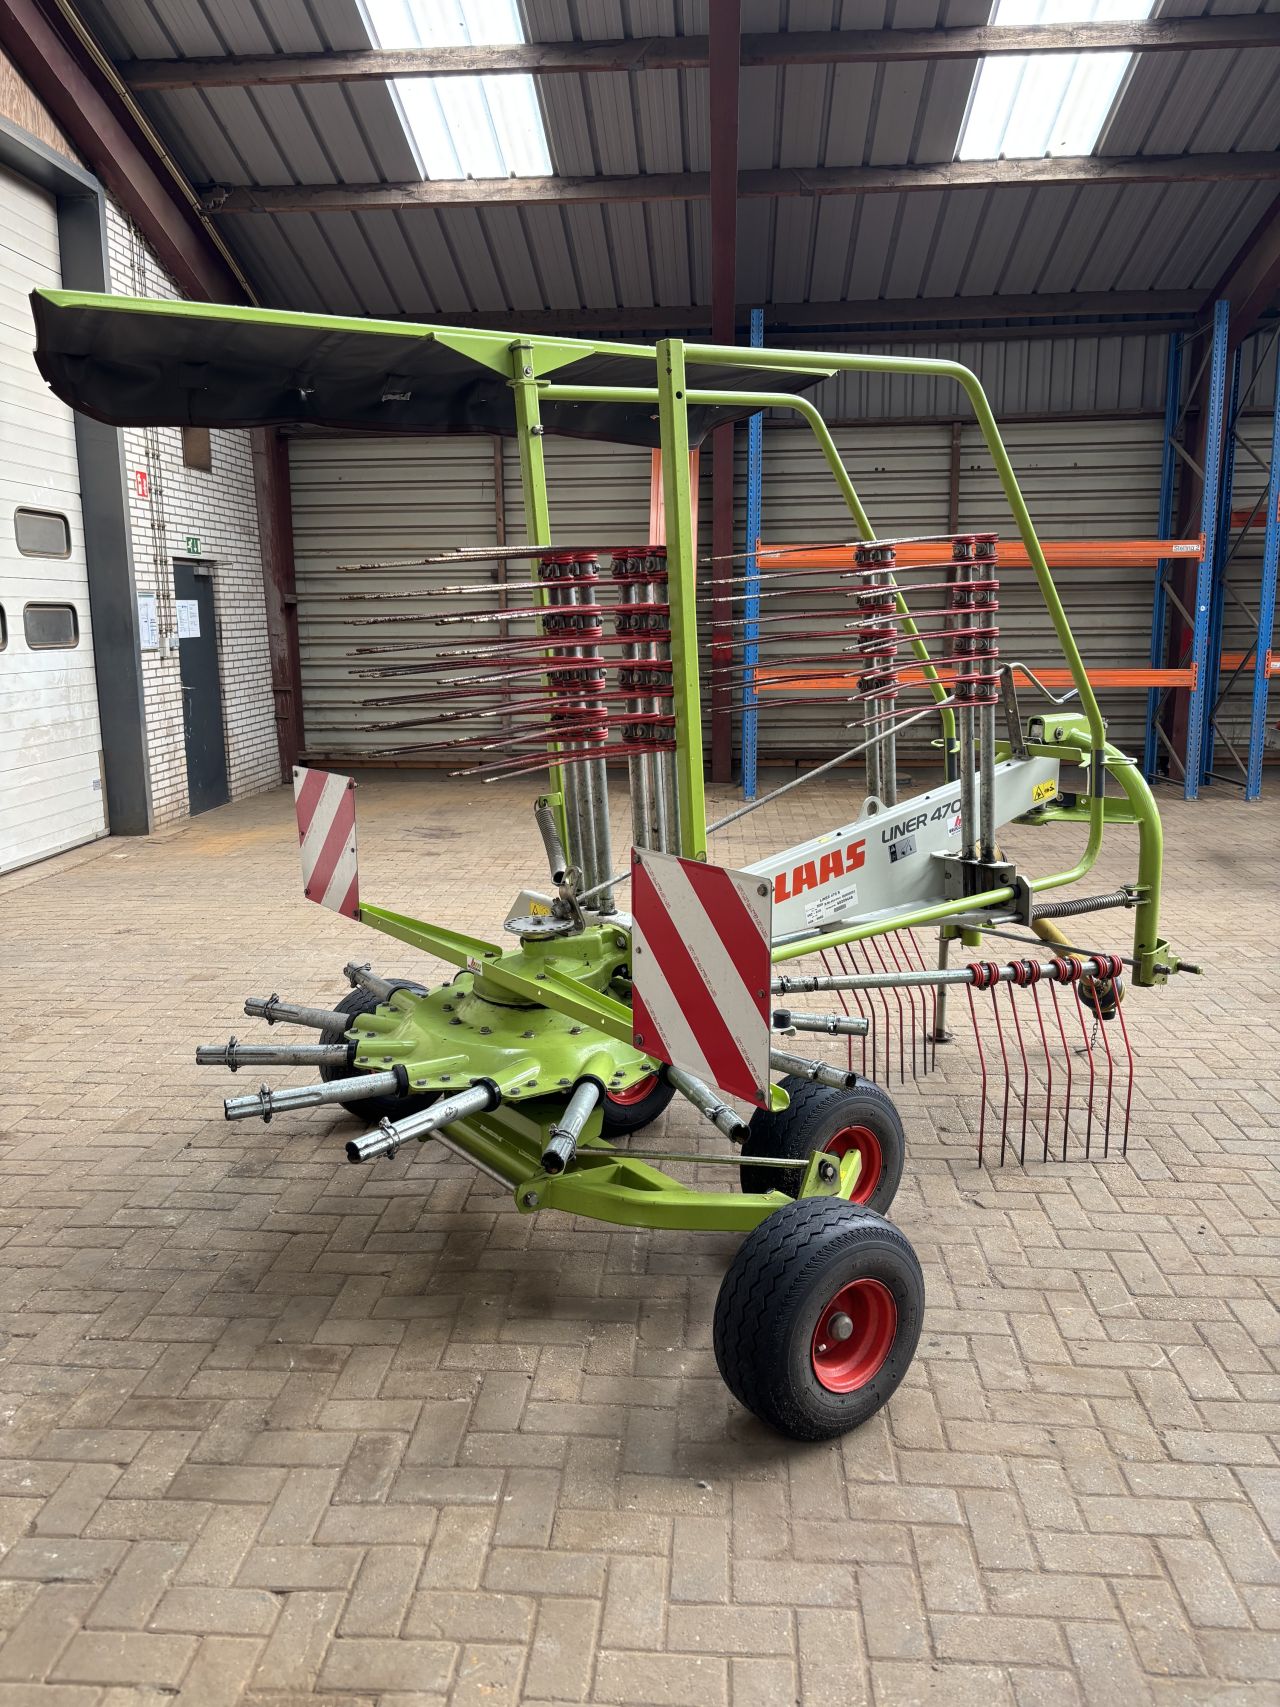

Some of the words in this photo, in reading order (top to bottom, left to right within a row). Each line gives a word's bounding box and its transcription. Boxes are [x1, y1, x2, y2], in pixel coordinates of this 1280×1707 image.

[882, 813, 927, 843] LINER
[930, 799, 962, 821] 470
[775, 838, 866, 904] LAAS
